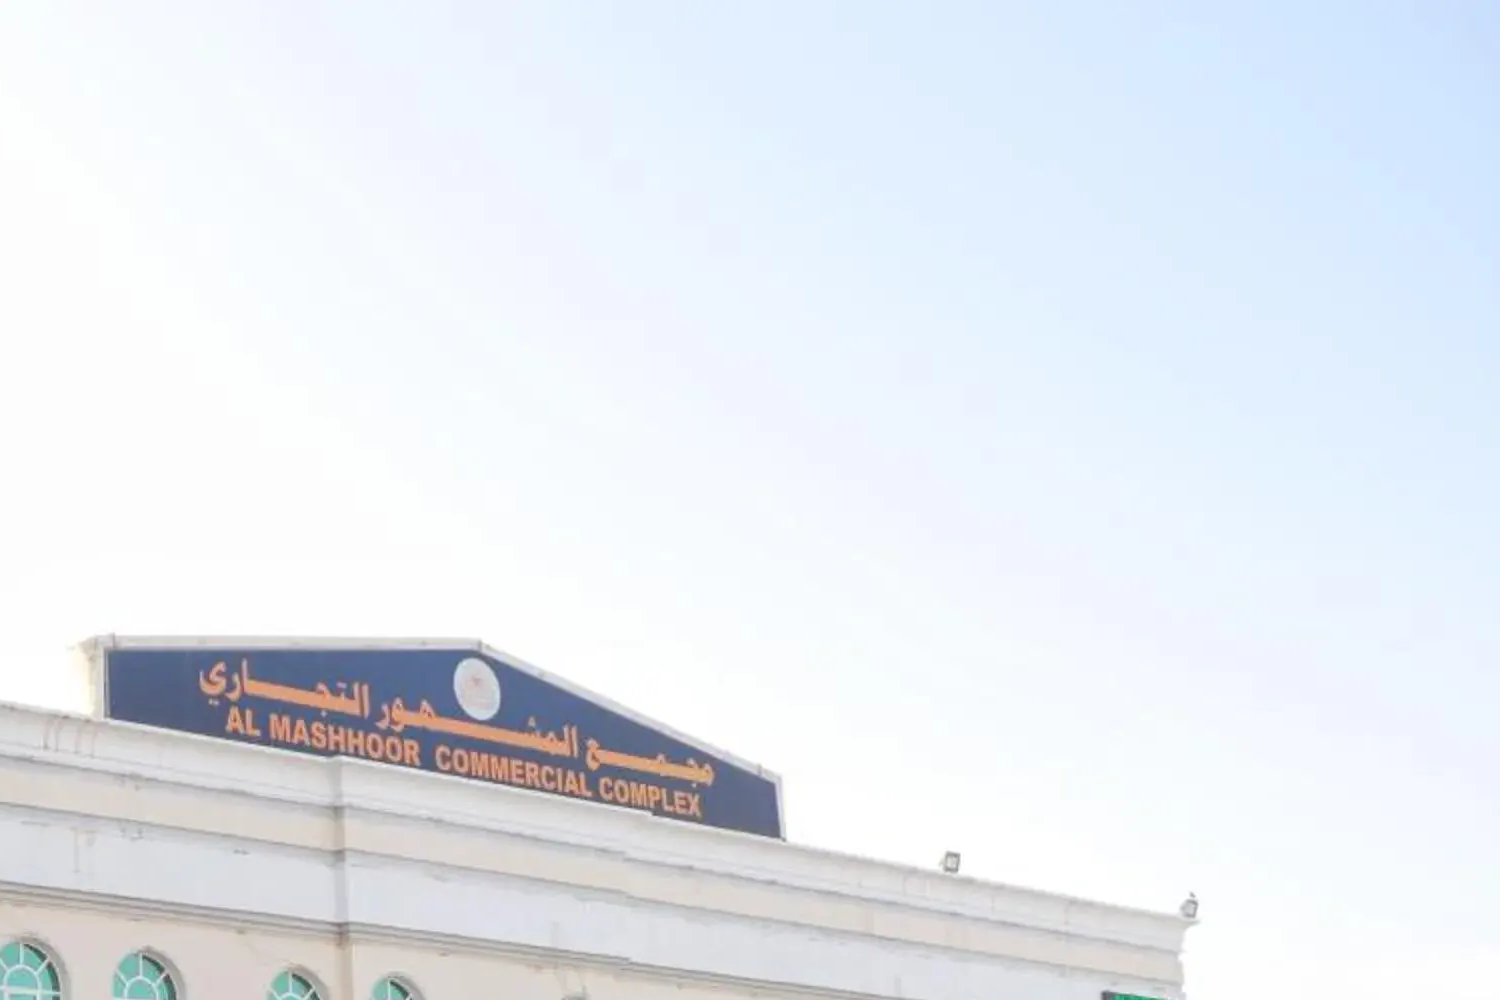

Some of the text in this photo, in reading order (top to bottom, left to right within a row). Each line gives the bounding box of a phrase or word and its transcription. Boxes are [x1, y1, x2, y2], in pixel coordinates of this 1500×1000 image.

[199, 658, 716, 787] مجمع المشهور التجاري
[225, 706, 703, 816] AL MASHHOOR COMMERCIAL COMPLEX
